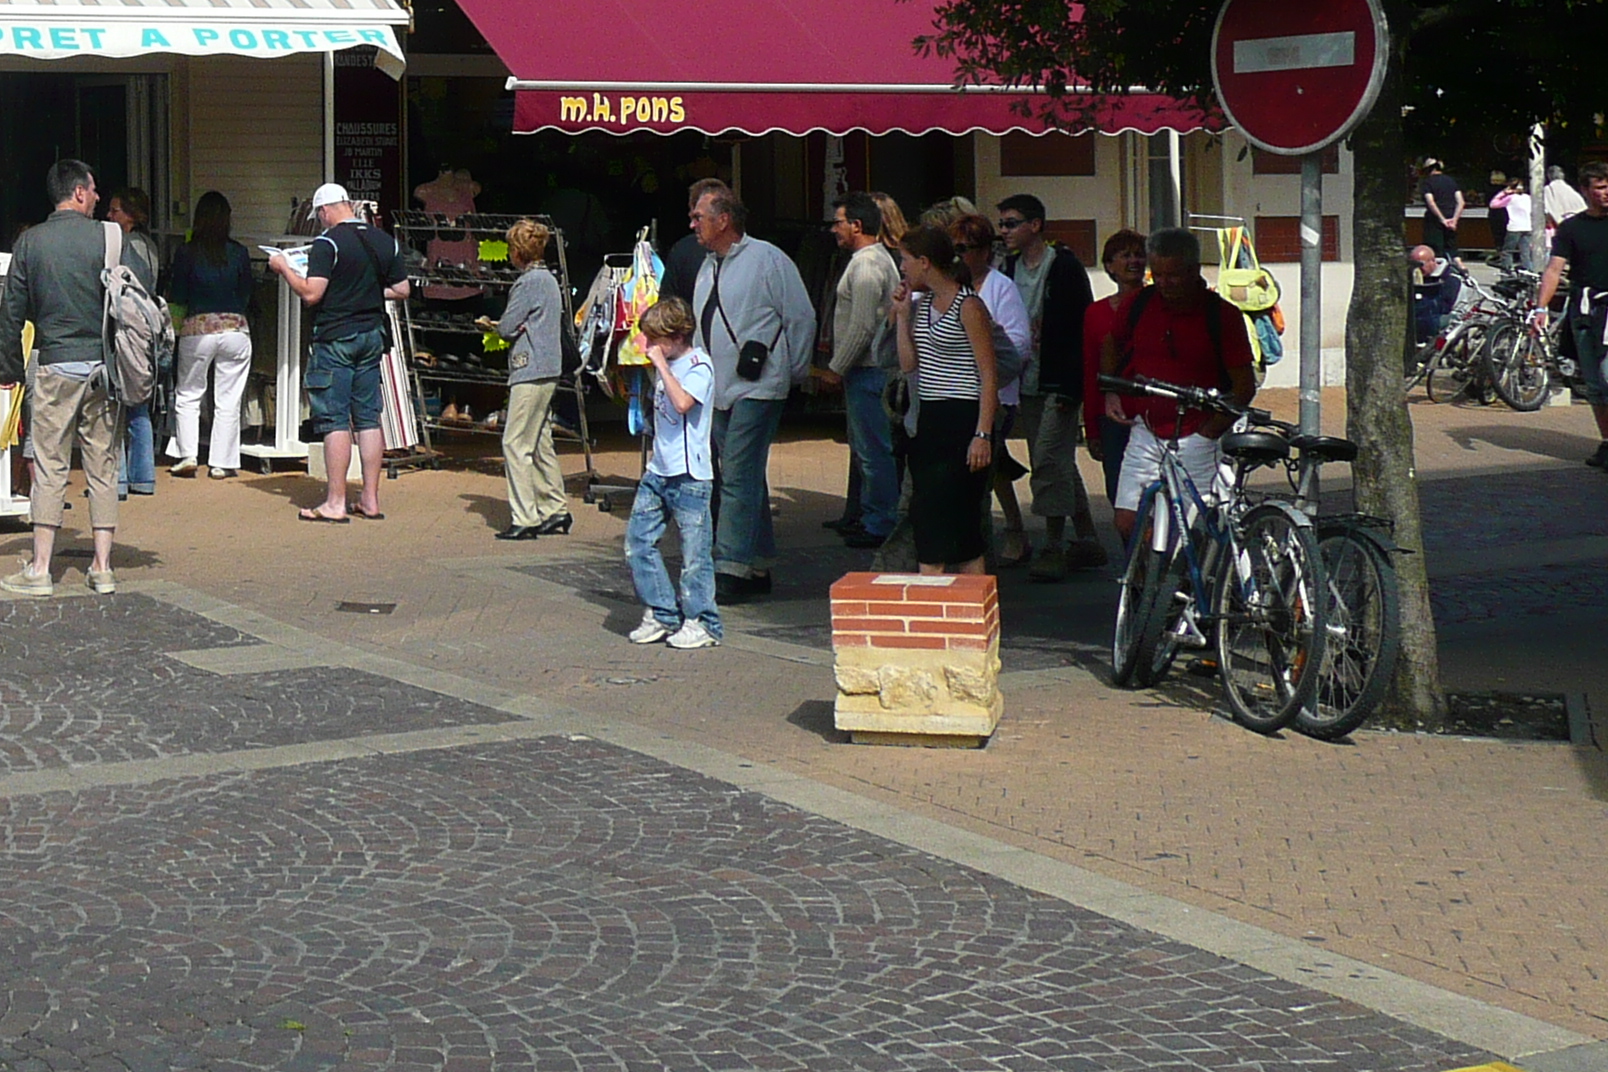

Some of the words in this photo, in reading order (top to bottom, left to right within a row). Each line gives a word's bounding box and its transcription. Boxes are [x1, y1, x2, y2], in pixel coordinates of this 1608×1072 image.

[140, 27, 172, 48] A
[192, 28, 390, 52] PORTER
[336, 122, 397, 135] CHAUSSURES
[350, 168, 382, 179] IKKS
